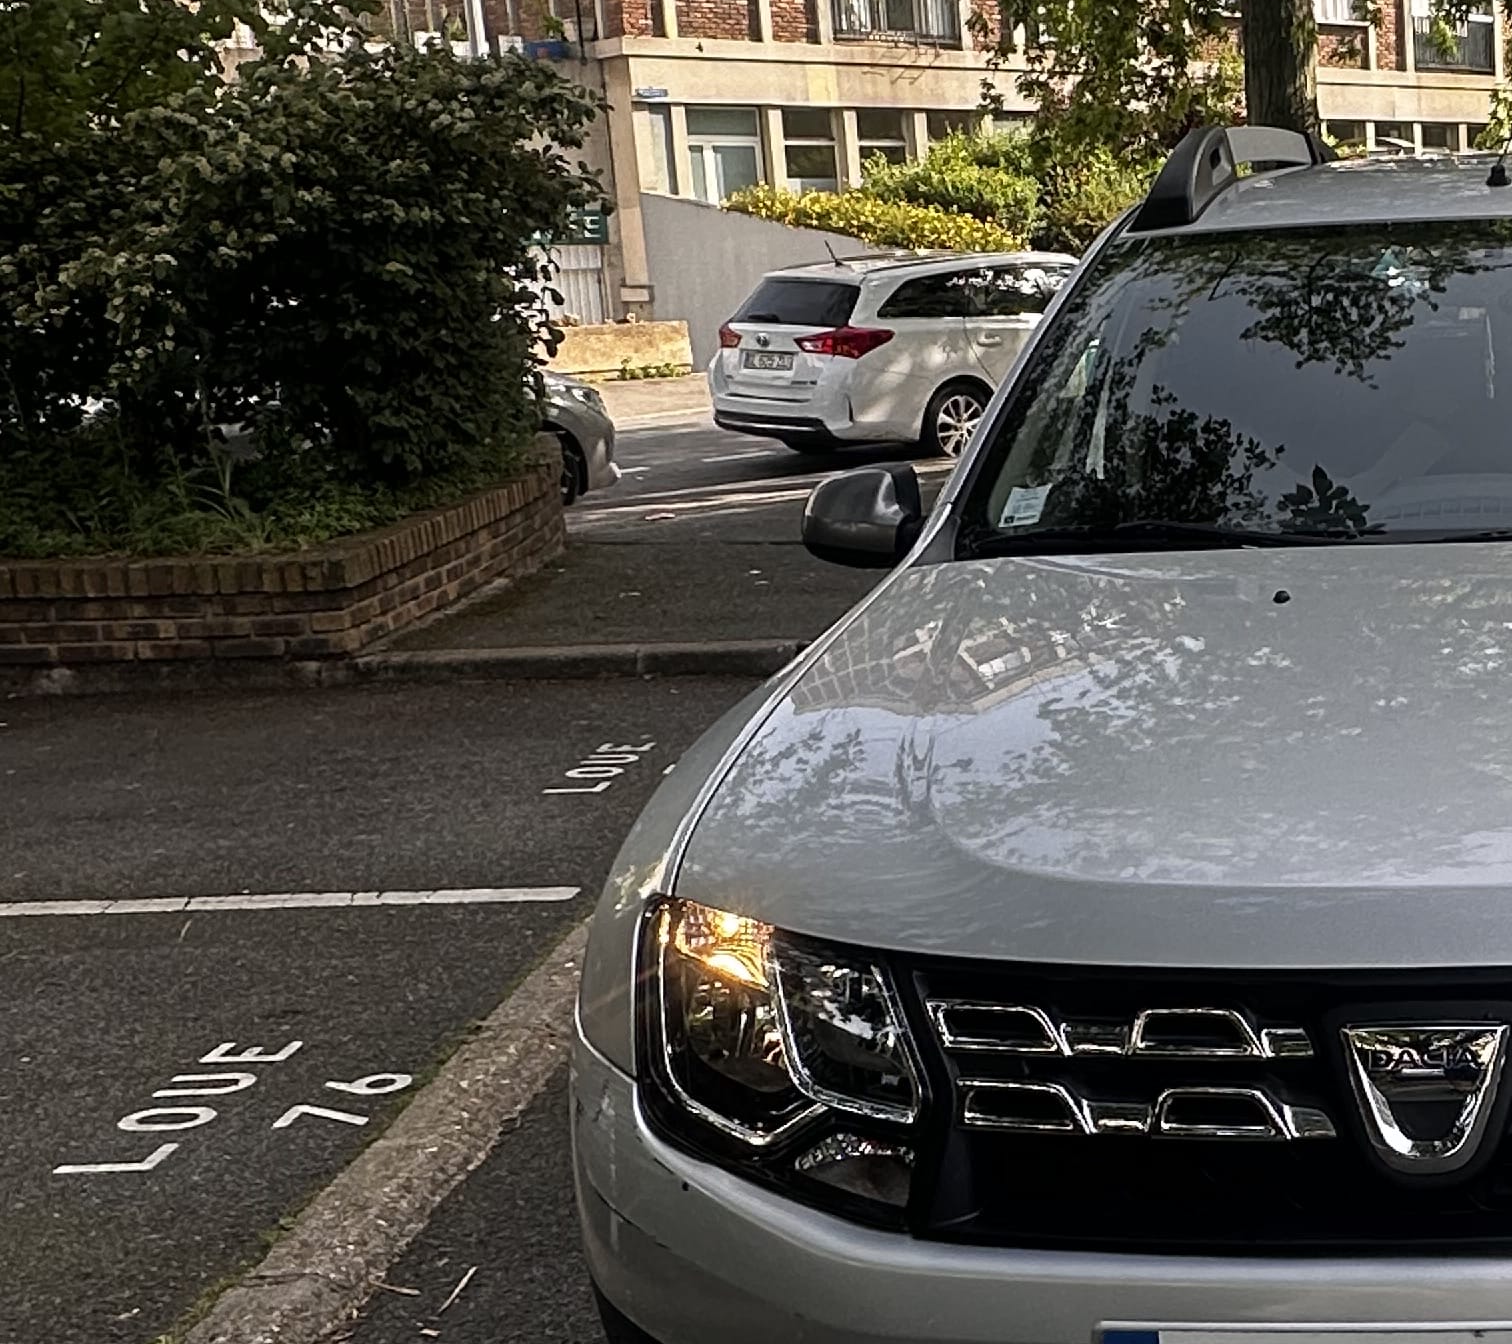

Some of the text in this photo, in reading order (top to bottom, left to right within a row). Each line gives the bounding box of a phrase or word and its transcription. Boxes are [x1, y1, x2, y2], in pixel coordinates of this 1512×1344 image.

[542, 742, 657, 794] LOUE
[1368, 1045, 1486, 1071] DACIA
[53, 1040, 303, 1174] LOUE
[272, 1073, 412, 1130] 76
